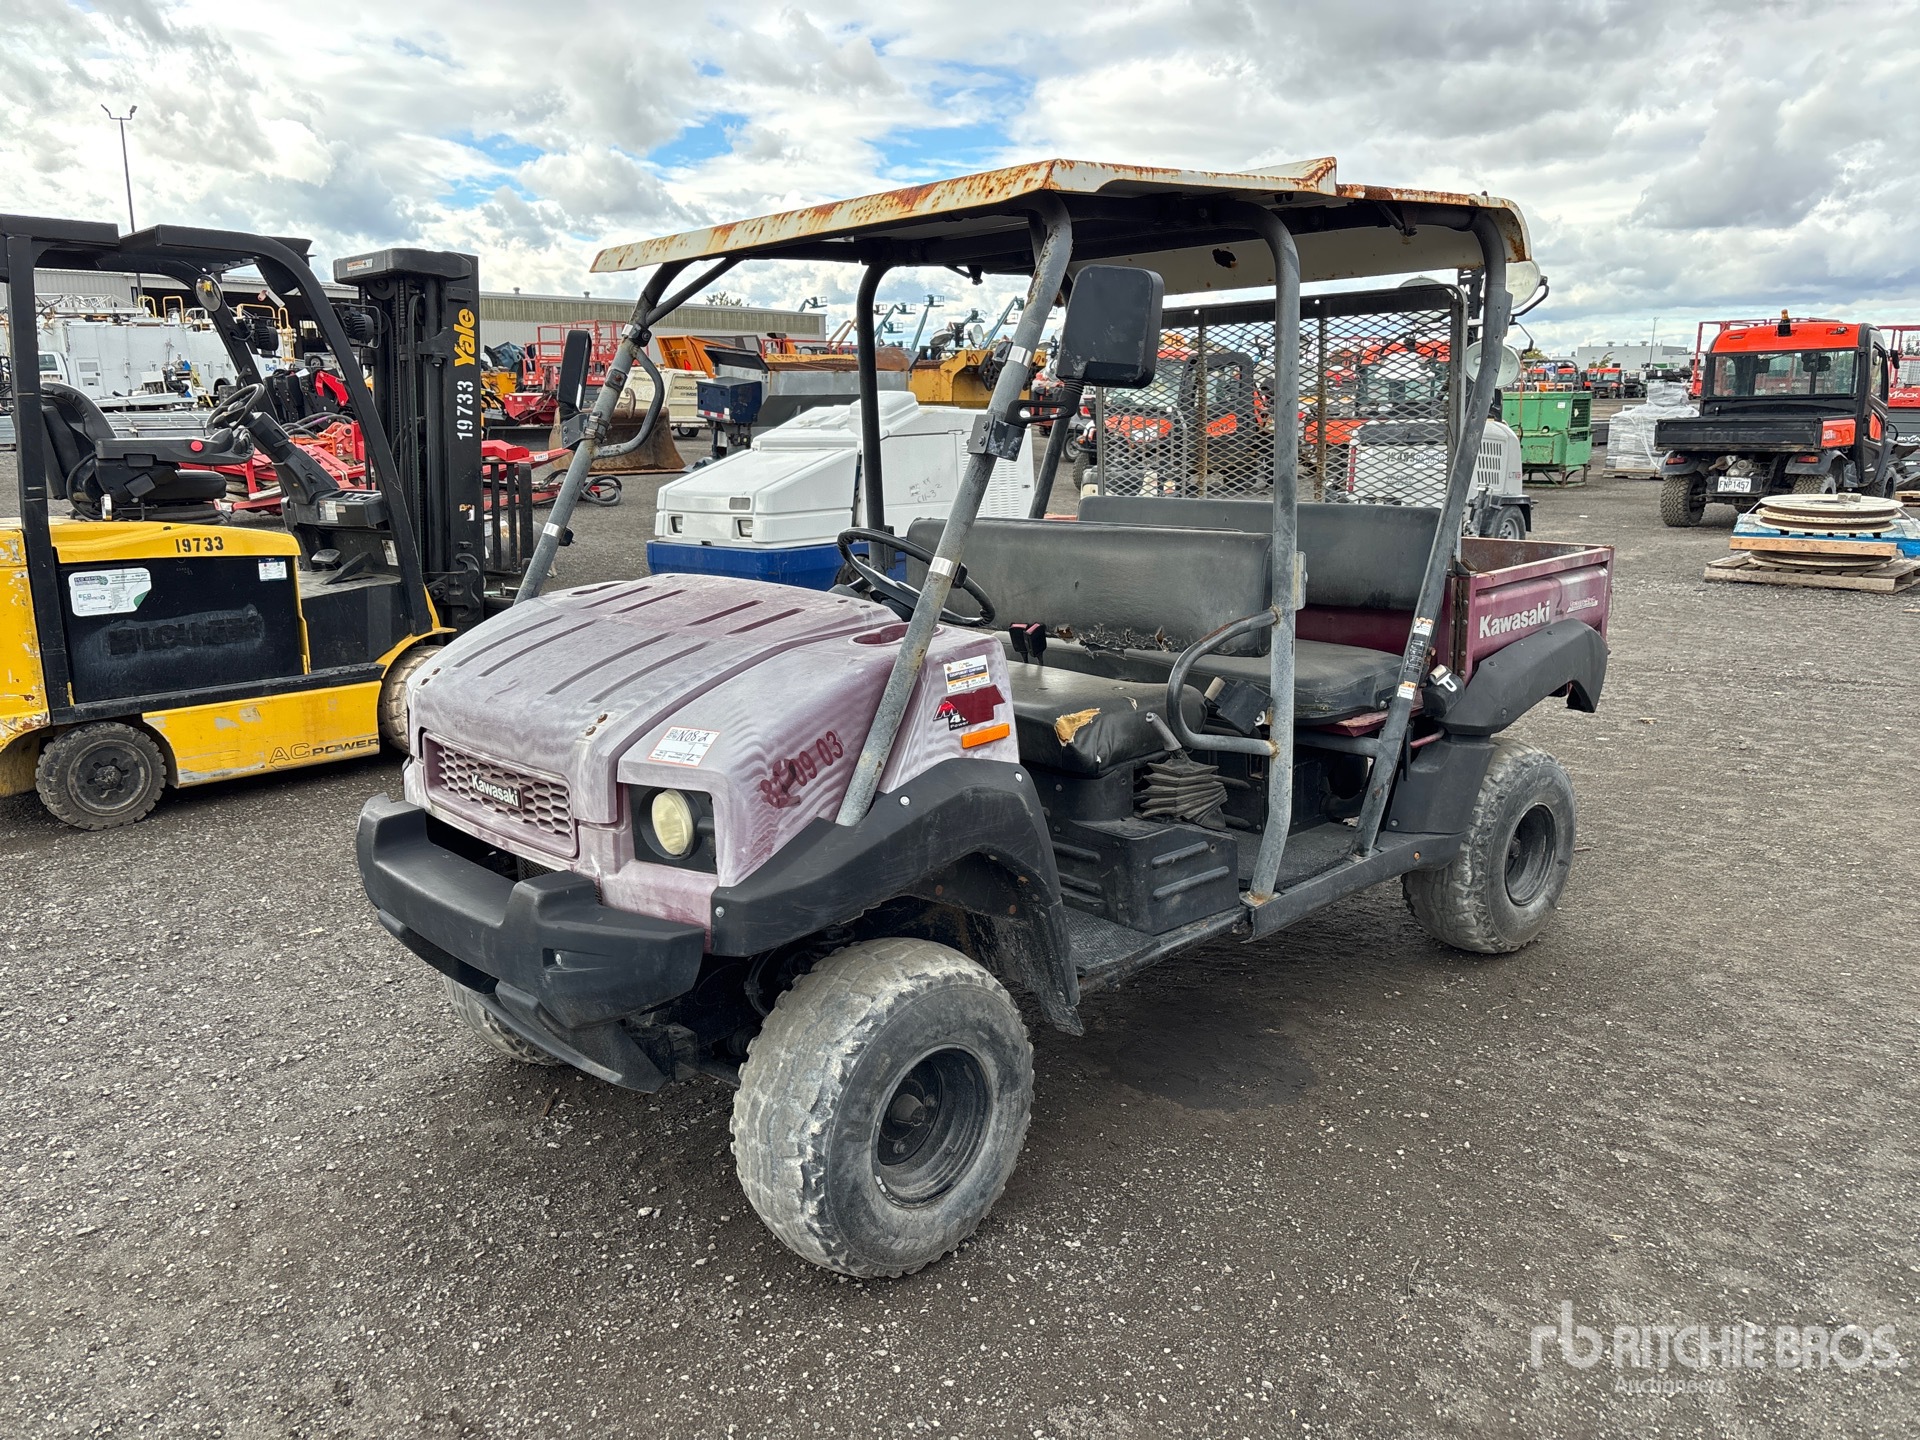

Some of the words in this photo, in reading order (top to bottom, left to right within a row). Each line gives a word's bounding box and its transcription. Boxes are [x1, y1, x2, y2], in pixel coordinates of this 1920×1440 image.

[453, 308, 476, 367] Yale
[456, 380, 474, 440] 19733
[1889, 391, 1919, 399] YJACK
[175, 536, 224, 553] 19733
[1479, 600, 1551, 639] Kawasaki
[268, 742, 310, 764] AC
[311, 738, 380, 756] POWER
[815, 730, 844, 767] 03
[471, 772, 520, 807] Kawasaki
